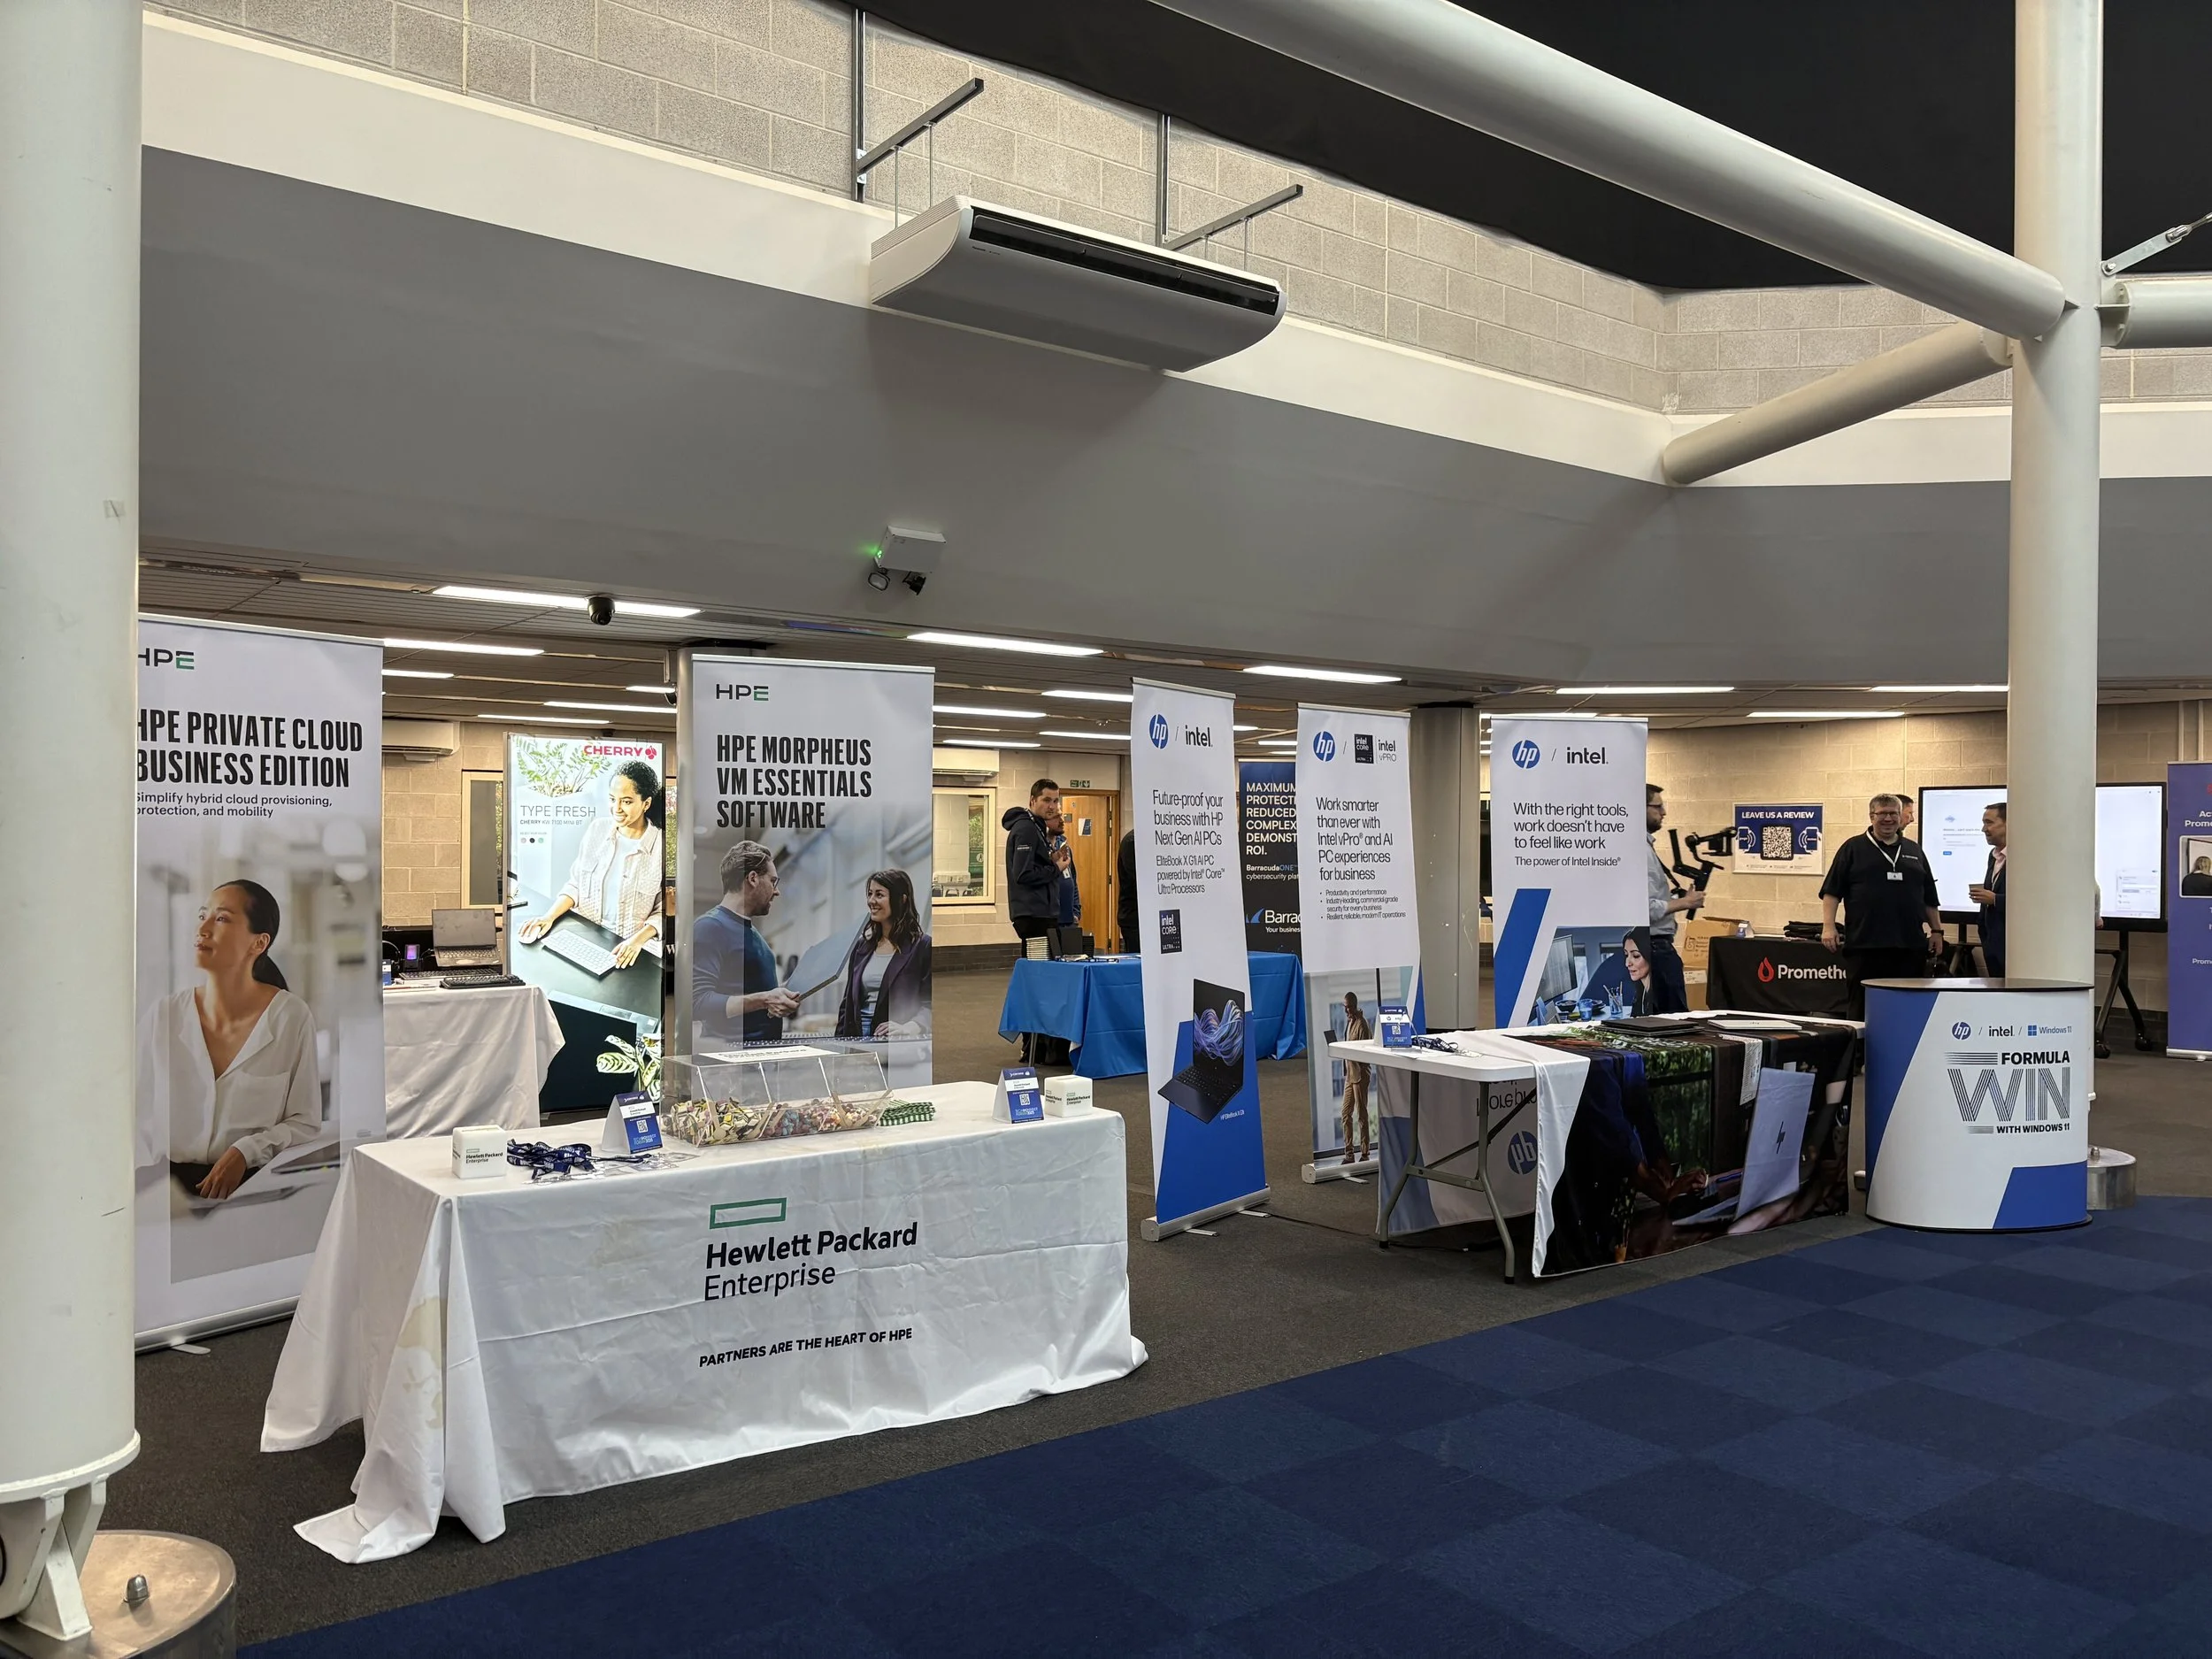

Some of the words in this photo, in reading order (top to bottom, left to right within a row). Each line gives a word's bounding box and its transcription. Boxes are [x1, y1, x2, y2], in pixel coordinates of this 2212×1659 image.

[137, 648, 195, 670] HPE
[716, 684, 769, 701] HPE
[137, 709, 180, 743] HPE
[187, 711, 287, 749] PRIVATE
[292, 718, 363, 752] CLOUD
[1149, 714, 1169, 749] hp
[583, 745, 643, 757] CHERRY
[717, 734, 757, 763] HPE
[762, 736, 872, 766] MORPHEUS
[1314, 732, 1335, 762] hp
[1378, 740, 1395, 752] intel
[1512, 740, 1540, 769] hp
[136, 749, 254, 786] BUSINESS
[259, 754, 349, 787] EDITION
[717, 767, 748, 795] VM
[753, 768, 872, 798] ESSENTIALS
[186, 793, 223, 805] hybrid
[225, 793, 258, 804] cloud
[261, 795, 333, 809] provisioning,
[1152, 789, 1204, 807] Future-proof
[1206, 793, 1224, 809] your
[1316, 797, 1341, 811] Work
[1342, 799, 1379, 812] smarter
[203, 806, 224, 816] and
[227, 806, 274, 818] mobility
[520, 805, 551, 817] TYPE
[555, 805, 596, 818] FRESH
[717, 800, 826, 829] SOFTWARE
[1246, 808, 1296, 818] REDUCED
[1513, 803, 1543, 816] With
[1545, 803, 1564, 816] the
[1566, 803, 1594, 818] right
[1597, 803, 1629, 818] tools,
[1154, 810, 1191, 826] business
[1192, 810, 1211, 827] with
[1211, 811, 1224, 826] HP
[1317, 815, 1340, 828] than
[1340, 818, 1361, 829] ever
[1362, 815, 1380, 828] with
[1514, 819, 1545, 832] work
[1547, 819, 1593, 833] doesn't
[1594, 820, 1625, 833] have
[1155, 830, 1174, 846] Next
[1174, 830, 1194, 846] Gen
[1194, 830, 1203, 846] AI
[1202, 830, 1223, 846] PCs
[1317, 833, 1339, 846] Intel
[1364, 833, 1382, 846] and
[1383, 833, 1394, 846] AI
[1514, 836, 1528, 849] to
[1530, 835, 1552, 849] feel
[1554, 835, 1572, 849] like
[1574, 836, 1606, 849] work
[1246, 845, 1268, 856] ROI.
[1318, 849, 1333, 863] PC
[1333, 850, 1391, 865] experiences
[1156, 855, 1183, 867] EliteBook
[1183, 855, 1189, 866] X
[1197, 855, 1204, 866] AI
[1204, 855, 1215, 865] PC
[1514, 856, 1532, 866] The
[1532, 858, 1560, 867] power
[1561, 856, 1571, 866] of
[1571, 856, 1591, 866] Intel
[1156, 870, 1182, 883] powered
[1182, 870, 1191, 882] by
[1246, 872, 1287, 881] cybersecurity
[1319, 867, 1334, 881] for
[1334, 867, 1376, 881] business
[1157, 884, 1171, 895] Ultra
[1171, 883, 1206, 895] Processors
[1161, 913, 1174, 926] intel
[1952, 1021, 1971, 1041] hp
[2001, 1050, 2070, 1065] FORMULA
[1947, 1067, 2070, 1122] WIN
[1996, 1125, 2021, 1134] WITH
[2023, 1124, 2063, 1133] WINDOWS
[706, 1233, 812, 1269] Hewlett
[817, 1222, 918, 1255] Packard
[704, 1263, 836, 1302] Enterprise
[699, 1345, 767, 1368] PARTNERS
[768, 1340, 794, 1356] ARE
[795, 1337, 822, 1351] THE
[824, 1332, 867, 1348] HEART
[869, 1331, 887, 1343] OF
[888, 1327, 913, 1342] HPE
